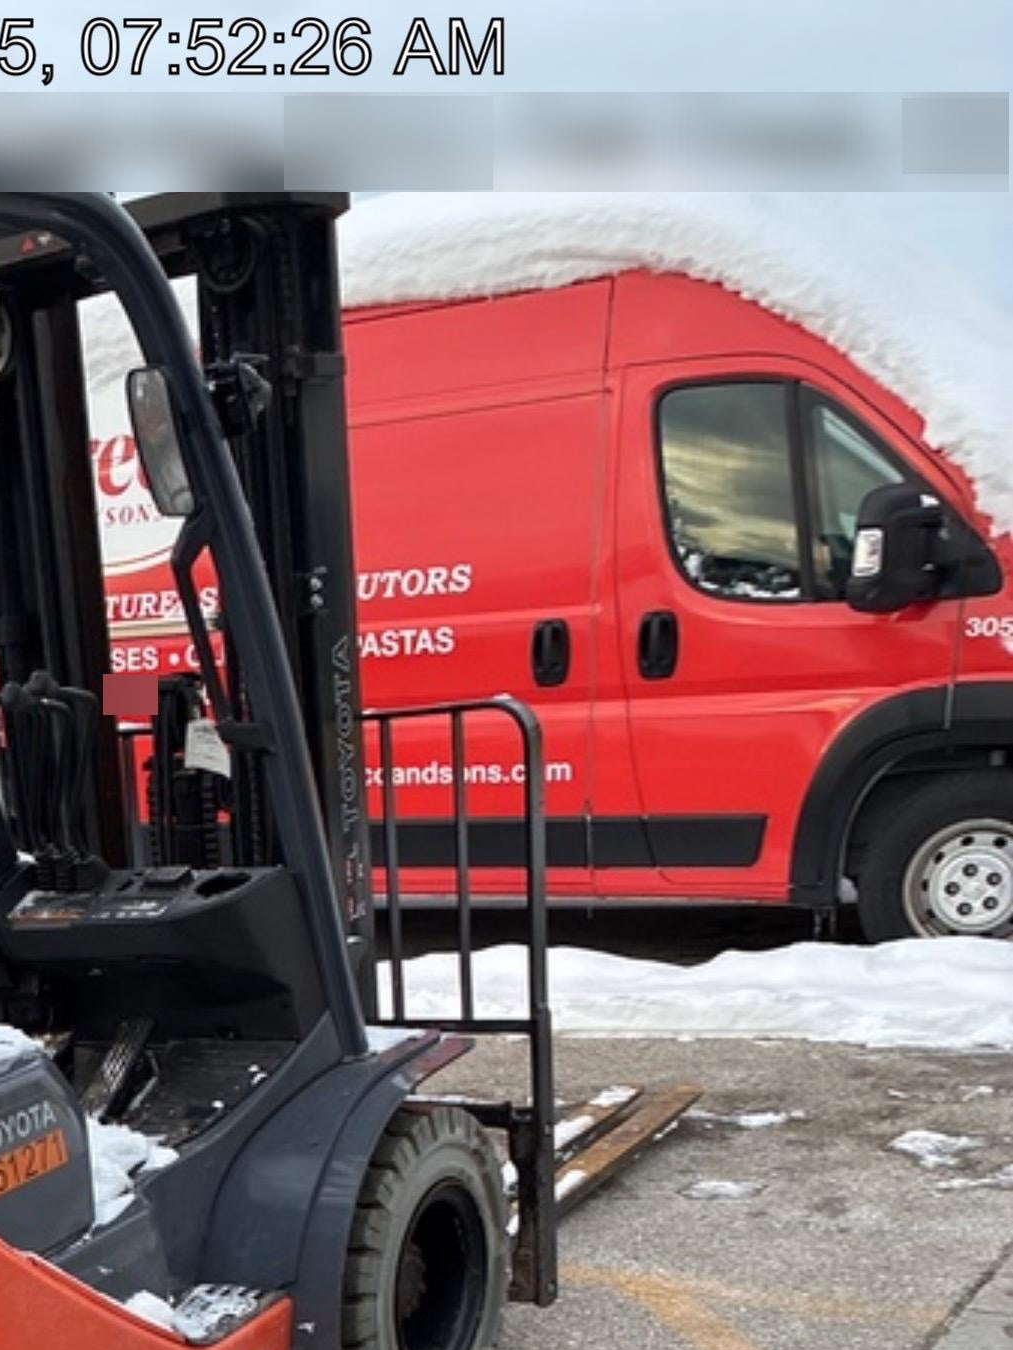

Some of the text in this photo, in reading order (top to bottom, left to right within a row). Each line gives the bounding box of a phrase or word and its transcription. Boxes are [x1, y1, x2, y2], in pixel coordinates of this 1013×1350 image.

[106, 504, 162, 526] SON
[105, 586, 219, 620] TURES
[357, 562, 472, 601] UTORS
